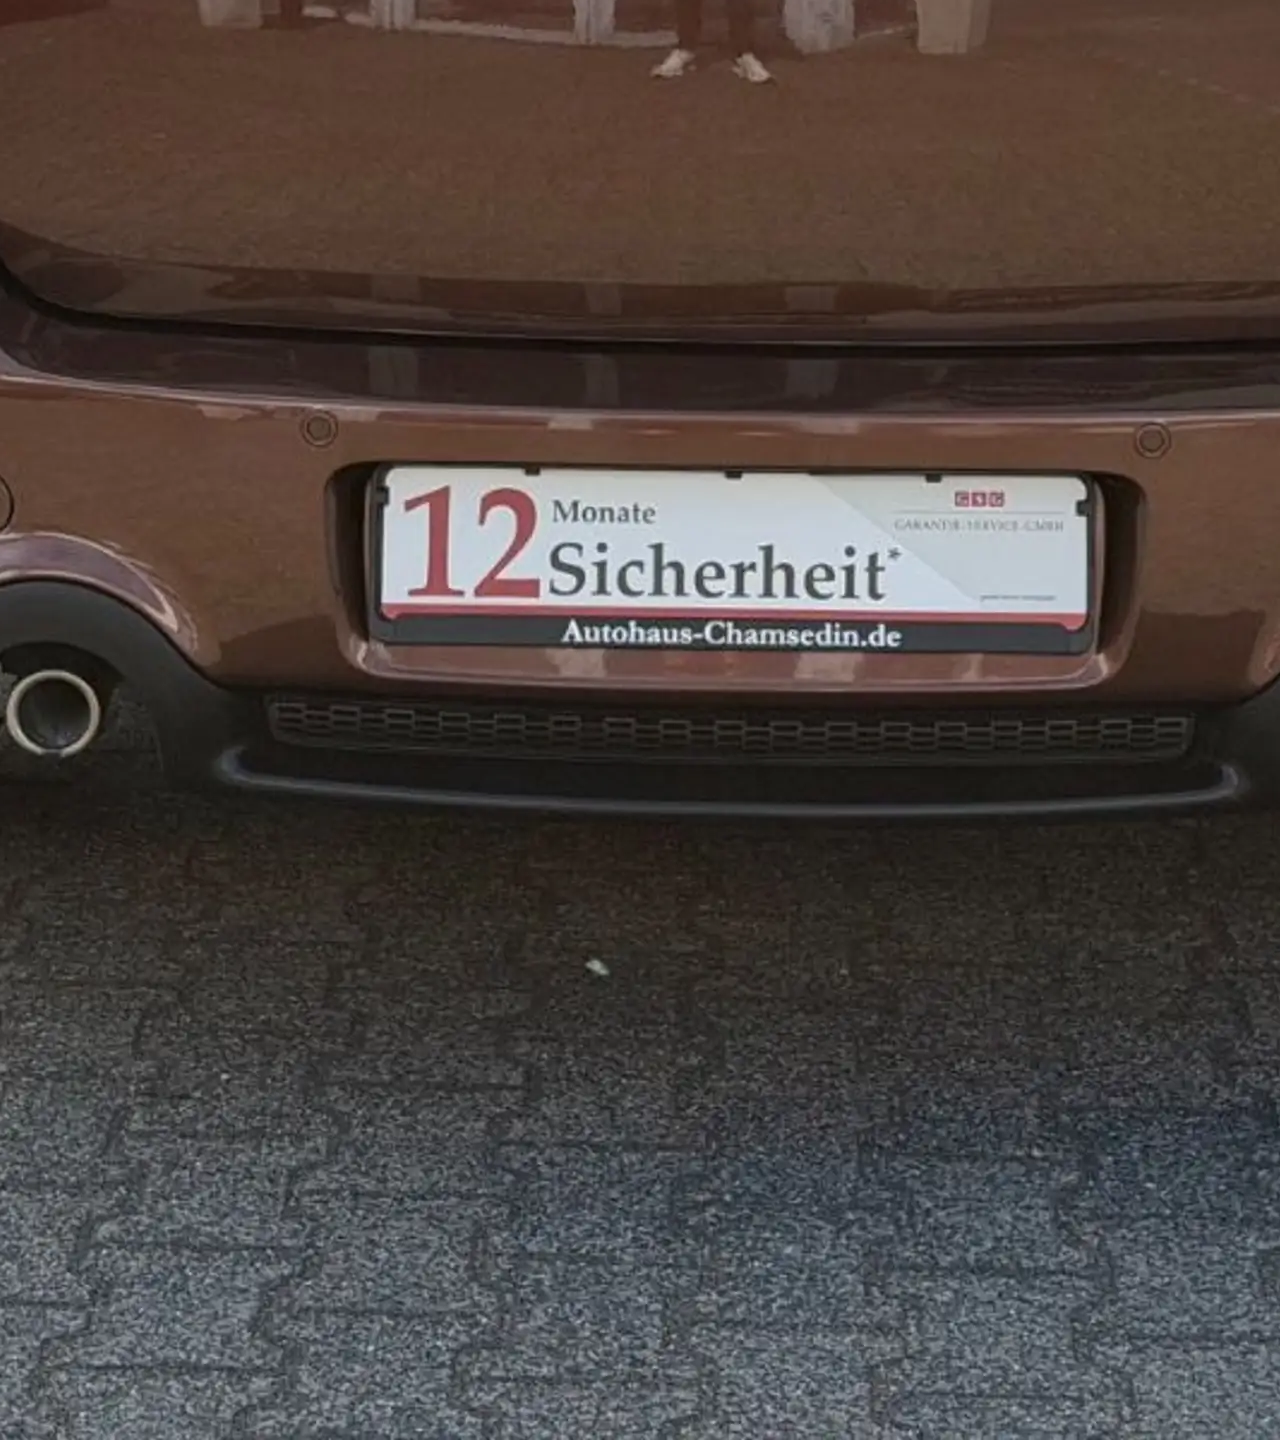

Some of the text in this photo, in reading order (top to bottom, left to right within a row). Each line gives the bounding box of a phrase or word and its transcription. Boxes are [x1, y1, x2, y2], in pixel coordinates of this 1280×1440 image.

[552, 499, 656, 525] Monate
[403, 484, 540, 599] 12
[561, 618, 903, 649] Autohaus-Chamsedin.de
